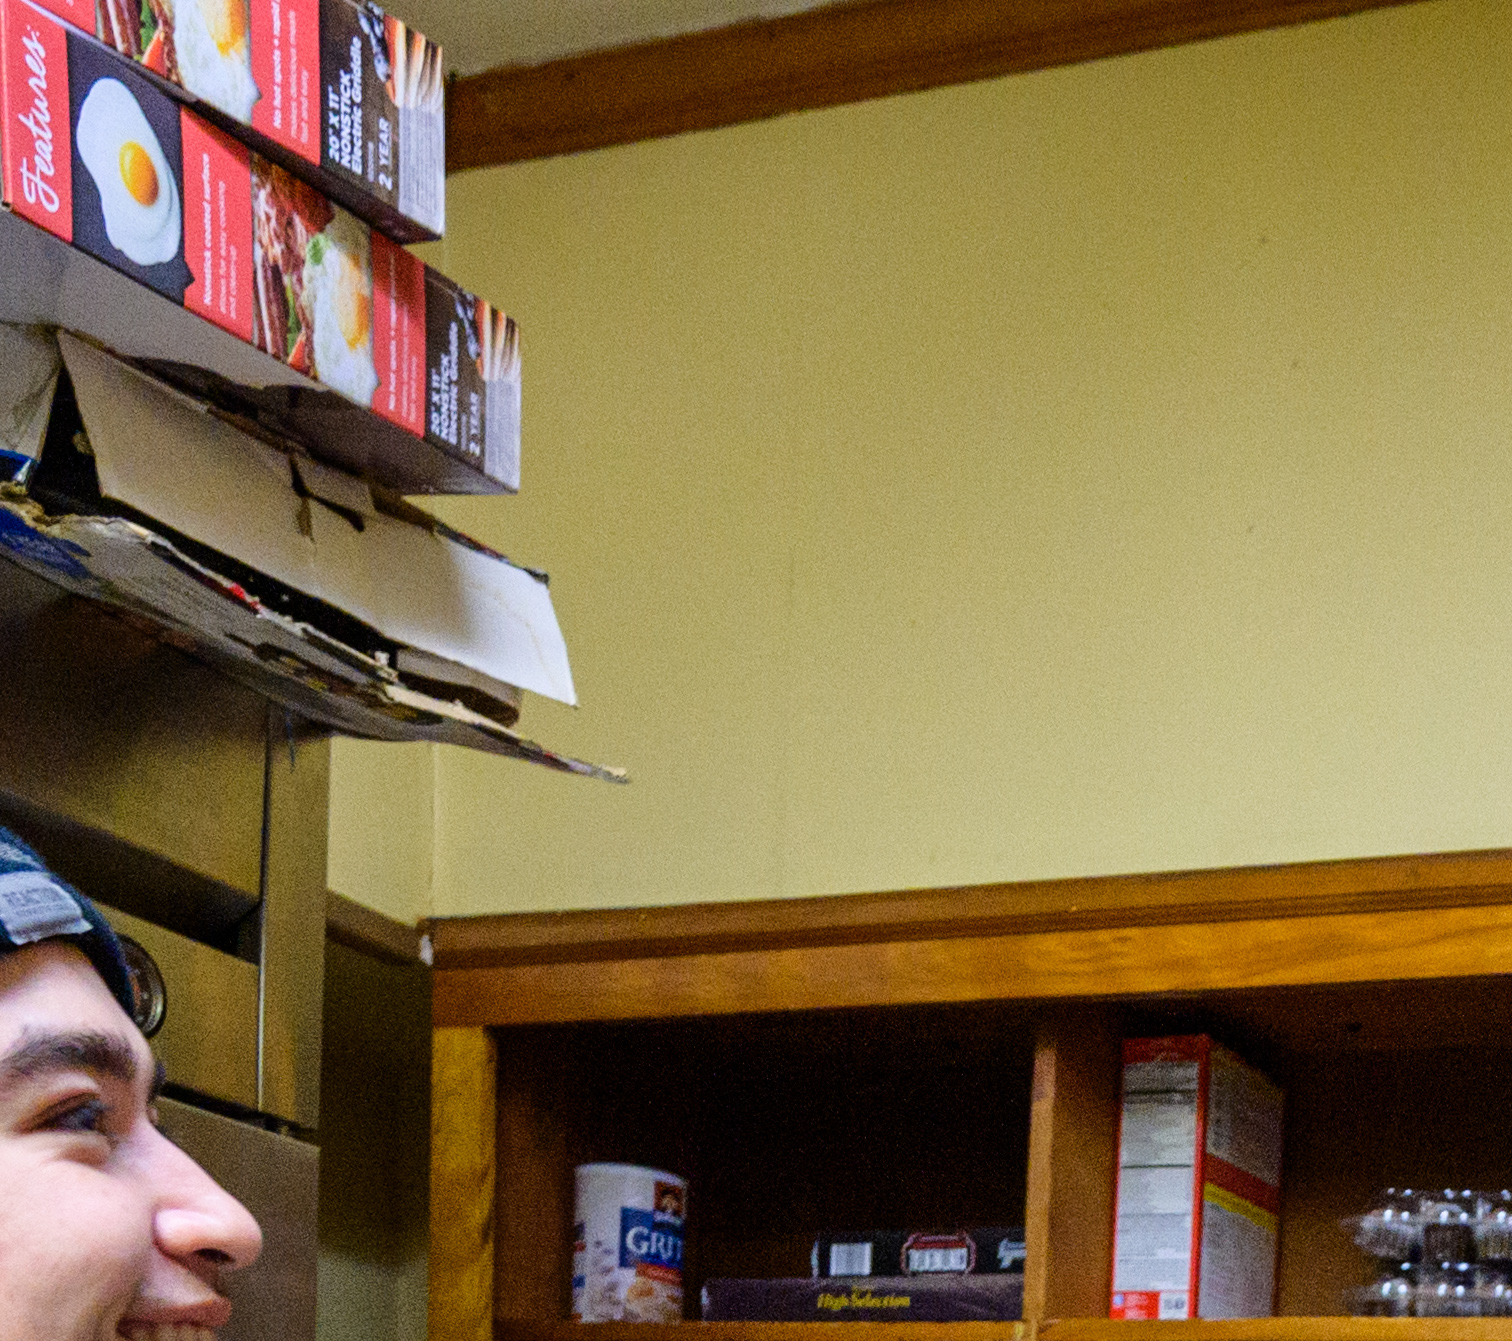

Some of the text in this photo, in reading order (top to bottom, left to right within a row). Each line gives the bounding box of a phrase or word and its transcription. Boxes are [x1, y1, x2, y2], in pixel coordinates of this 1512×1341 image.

[20, 24, 61, 214] Features:
[340, 69, 352, 168] NONSTICK
[350, 36, 362, 174] Electric Griddle
[201, 153, 210, 200] surface
[378, 117, 392, 191] 2 YEAR
[202, 201, 211, 248] coated
[440, 353, 451, 440] NONSTICK
[449, 321, 459, 445] Electric Griddle
[469, 392, 481, 456] 2 YEAR
